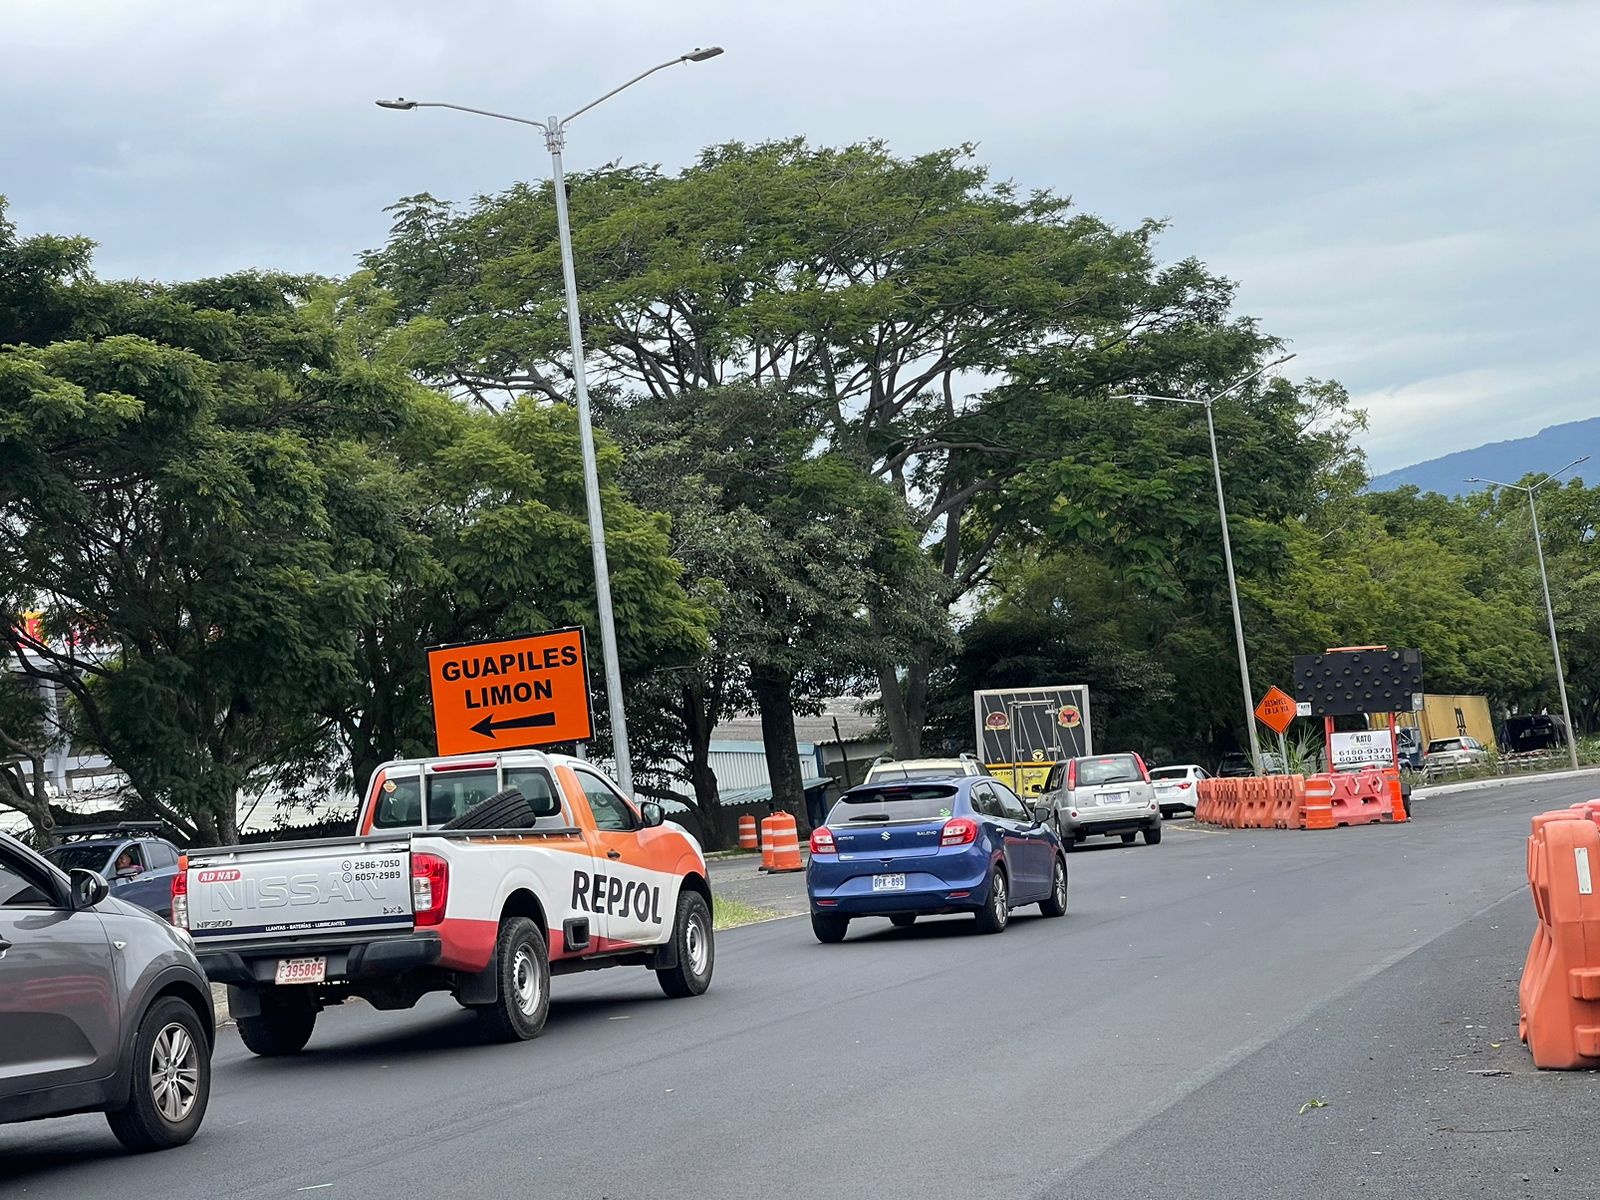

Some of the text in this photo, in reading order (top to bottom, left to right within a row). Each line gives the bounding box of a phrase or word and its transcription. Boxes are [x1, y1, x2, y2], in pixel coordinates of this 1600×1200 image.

[442, 645, 578, 682] GUAPILES
[465, 679, 553, 709] LIMON
[1264, 707, 1271, 715] EN
[1272, 706, 1279, 714] LA
[1356, 734, 1372, 743] KATO
[354, 859, 401, 870] 2586-7050
[200, 870, 239, 882] AD NAT
[355, 871, 401, 882] 6057-2989
[874, 876, 904, 888] BPK-899
[210, 872, 386, 912] NISSAN
[571, 870, 662, 924] REPSOL
[196, 919, 233, 929] NP300
[314, 920, 347, 928] LUBRICANTES
[285, 962, 323, 978] 395885
